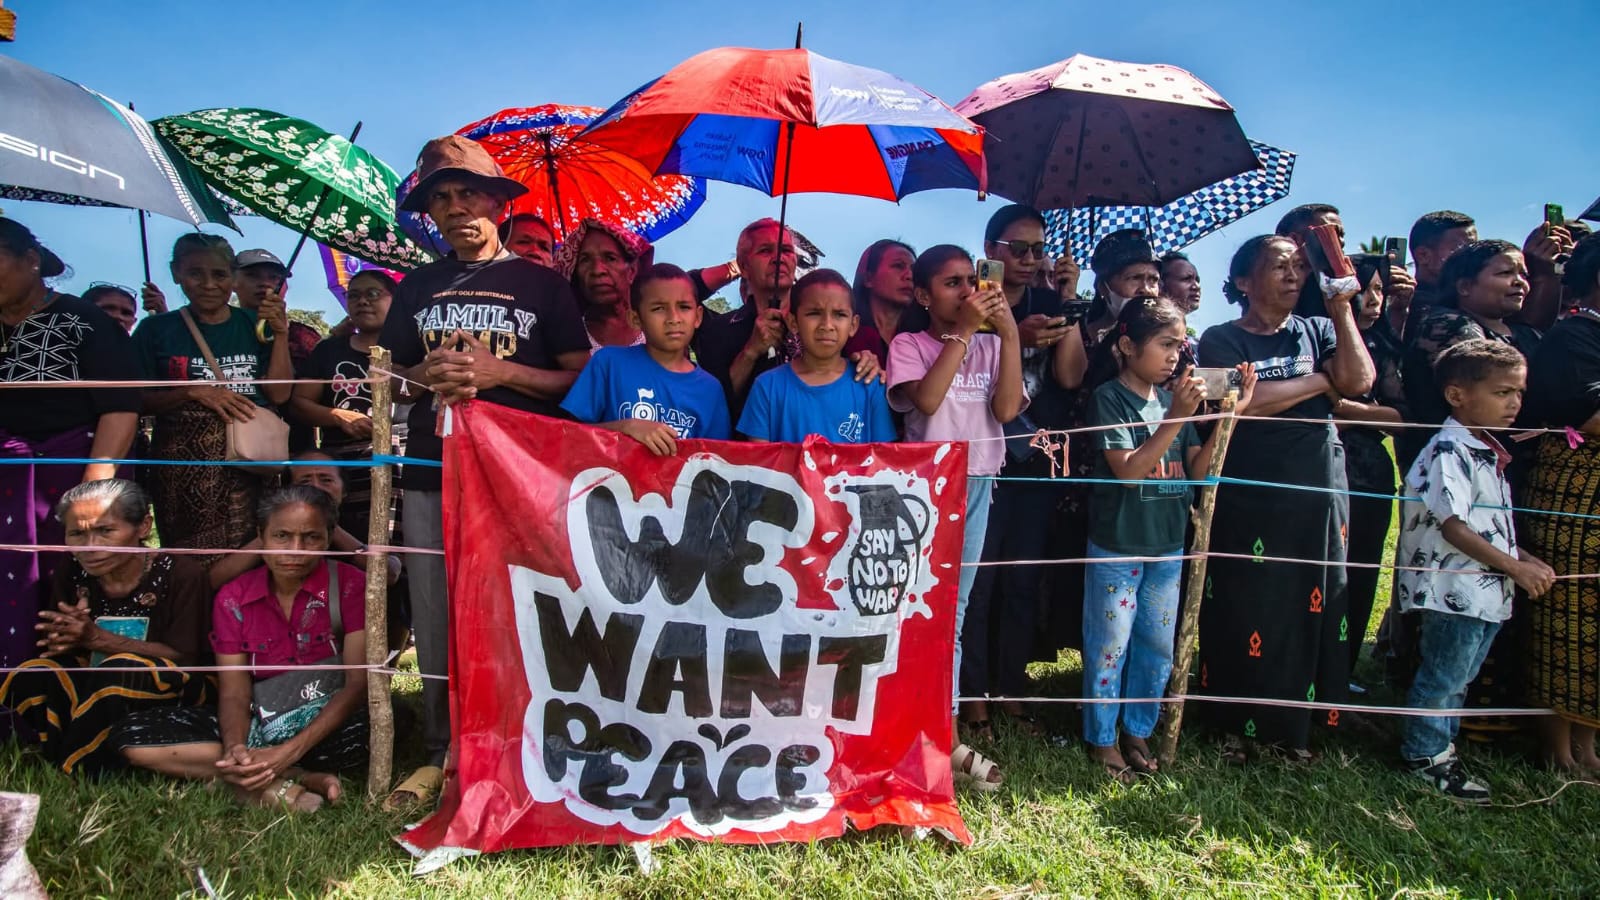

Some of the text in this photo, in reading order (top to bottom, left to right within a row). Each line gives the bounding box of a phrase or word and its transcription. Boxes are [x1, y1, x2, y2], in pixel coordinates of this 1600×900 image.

[414, 303, 537, 340] FAMILY
[1257, 368, 1282, 379] UCCI
[585, 469, 799, 618] WE
[859, 529, 895, 556] SAY
[853, 557, 907, 586] NO TO
[856, 587, 898, 614] WAR
[534, 590, 888, 721] WANT
[543, 698, 820, 825] PEACE
